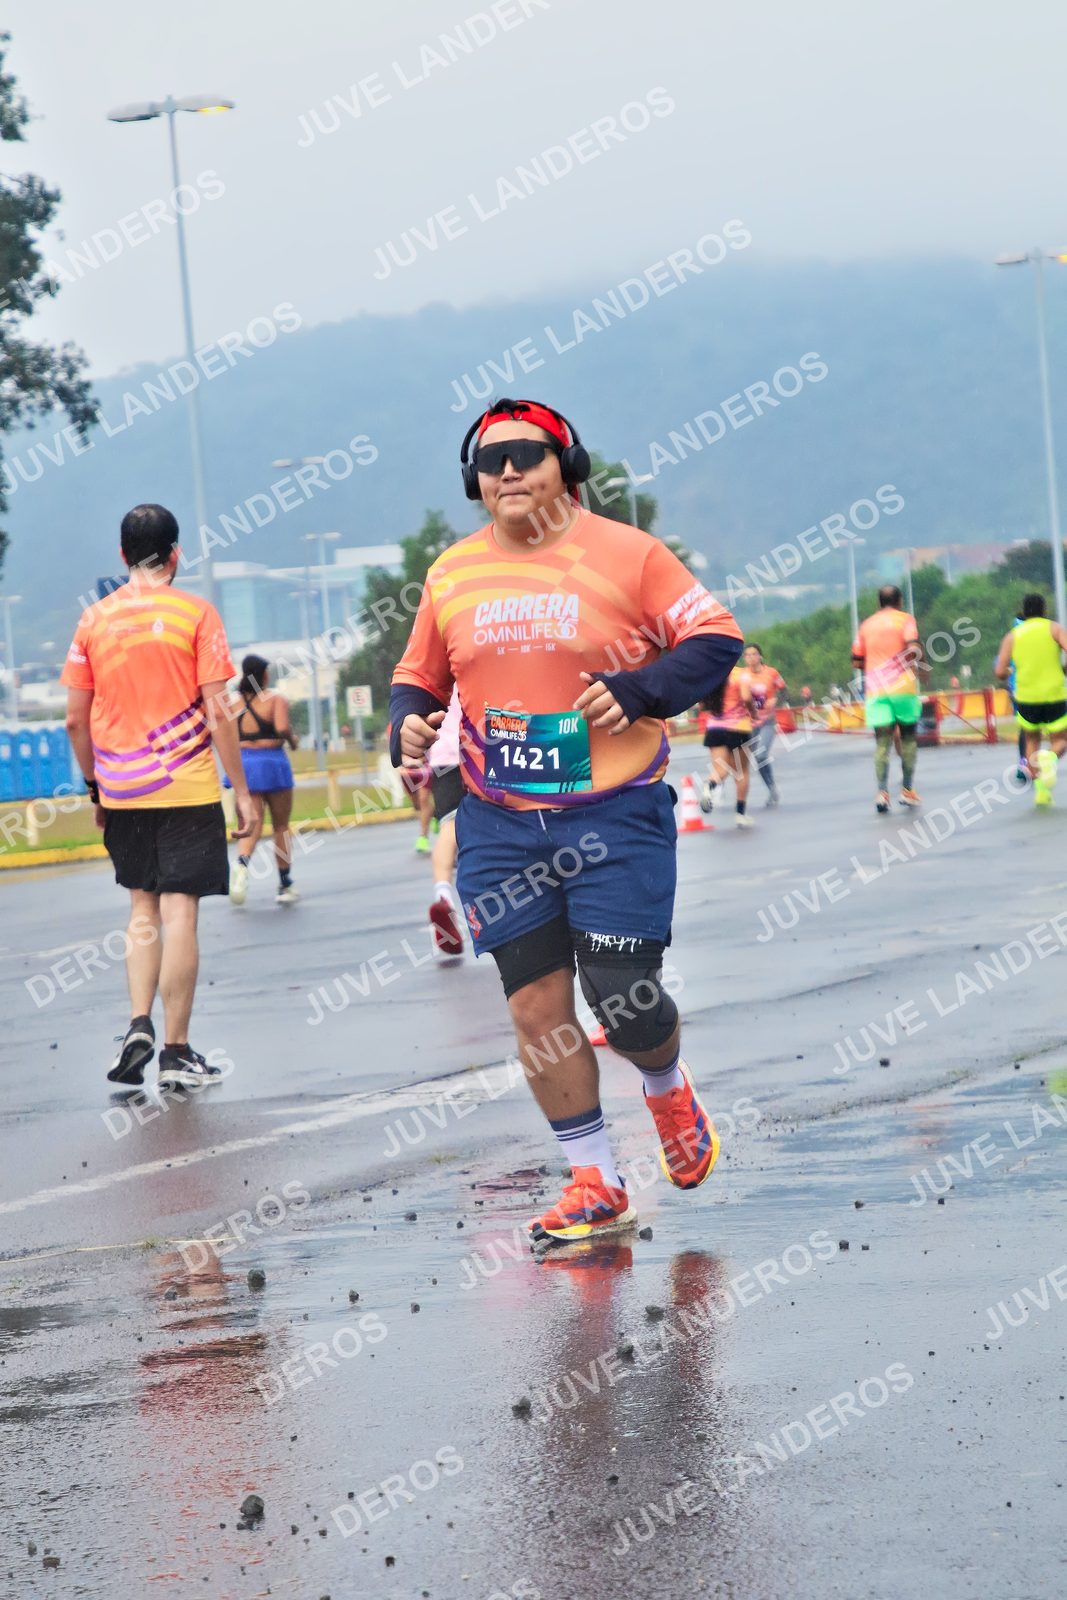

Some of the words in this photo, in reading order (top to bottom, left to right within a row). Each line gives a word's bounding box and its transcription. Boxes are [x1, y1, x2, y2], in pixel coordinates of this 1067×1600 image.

[474, 593, 580, 627] CARRERA
[473, 622, 553, 646] OMNILIFE
[490, 716, 527, 731] CARRERA
[558, 717, 579, 735] 10K
[490, 728, 518, 741] OMNILIFE
[500, 744, 560, 770] 1421
